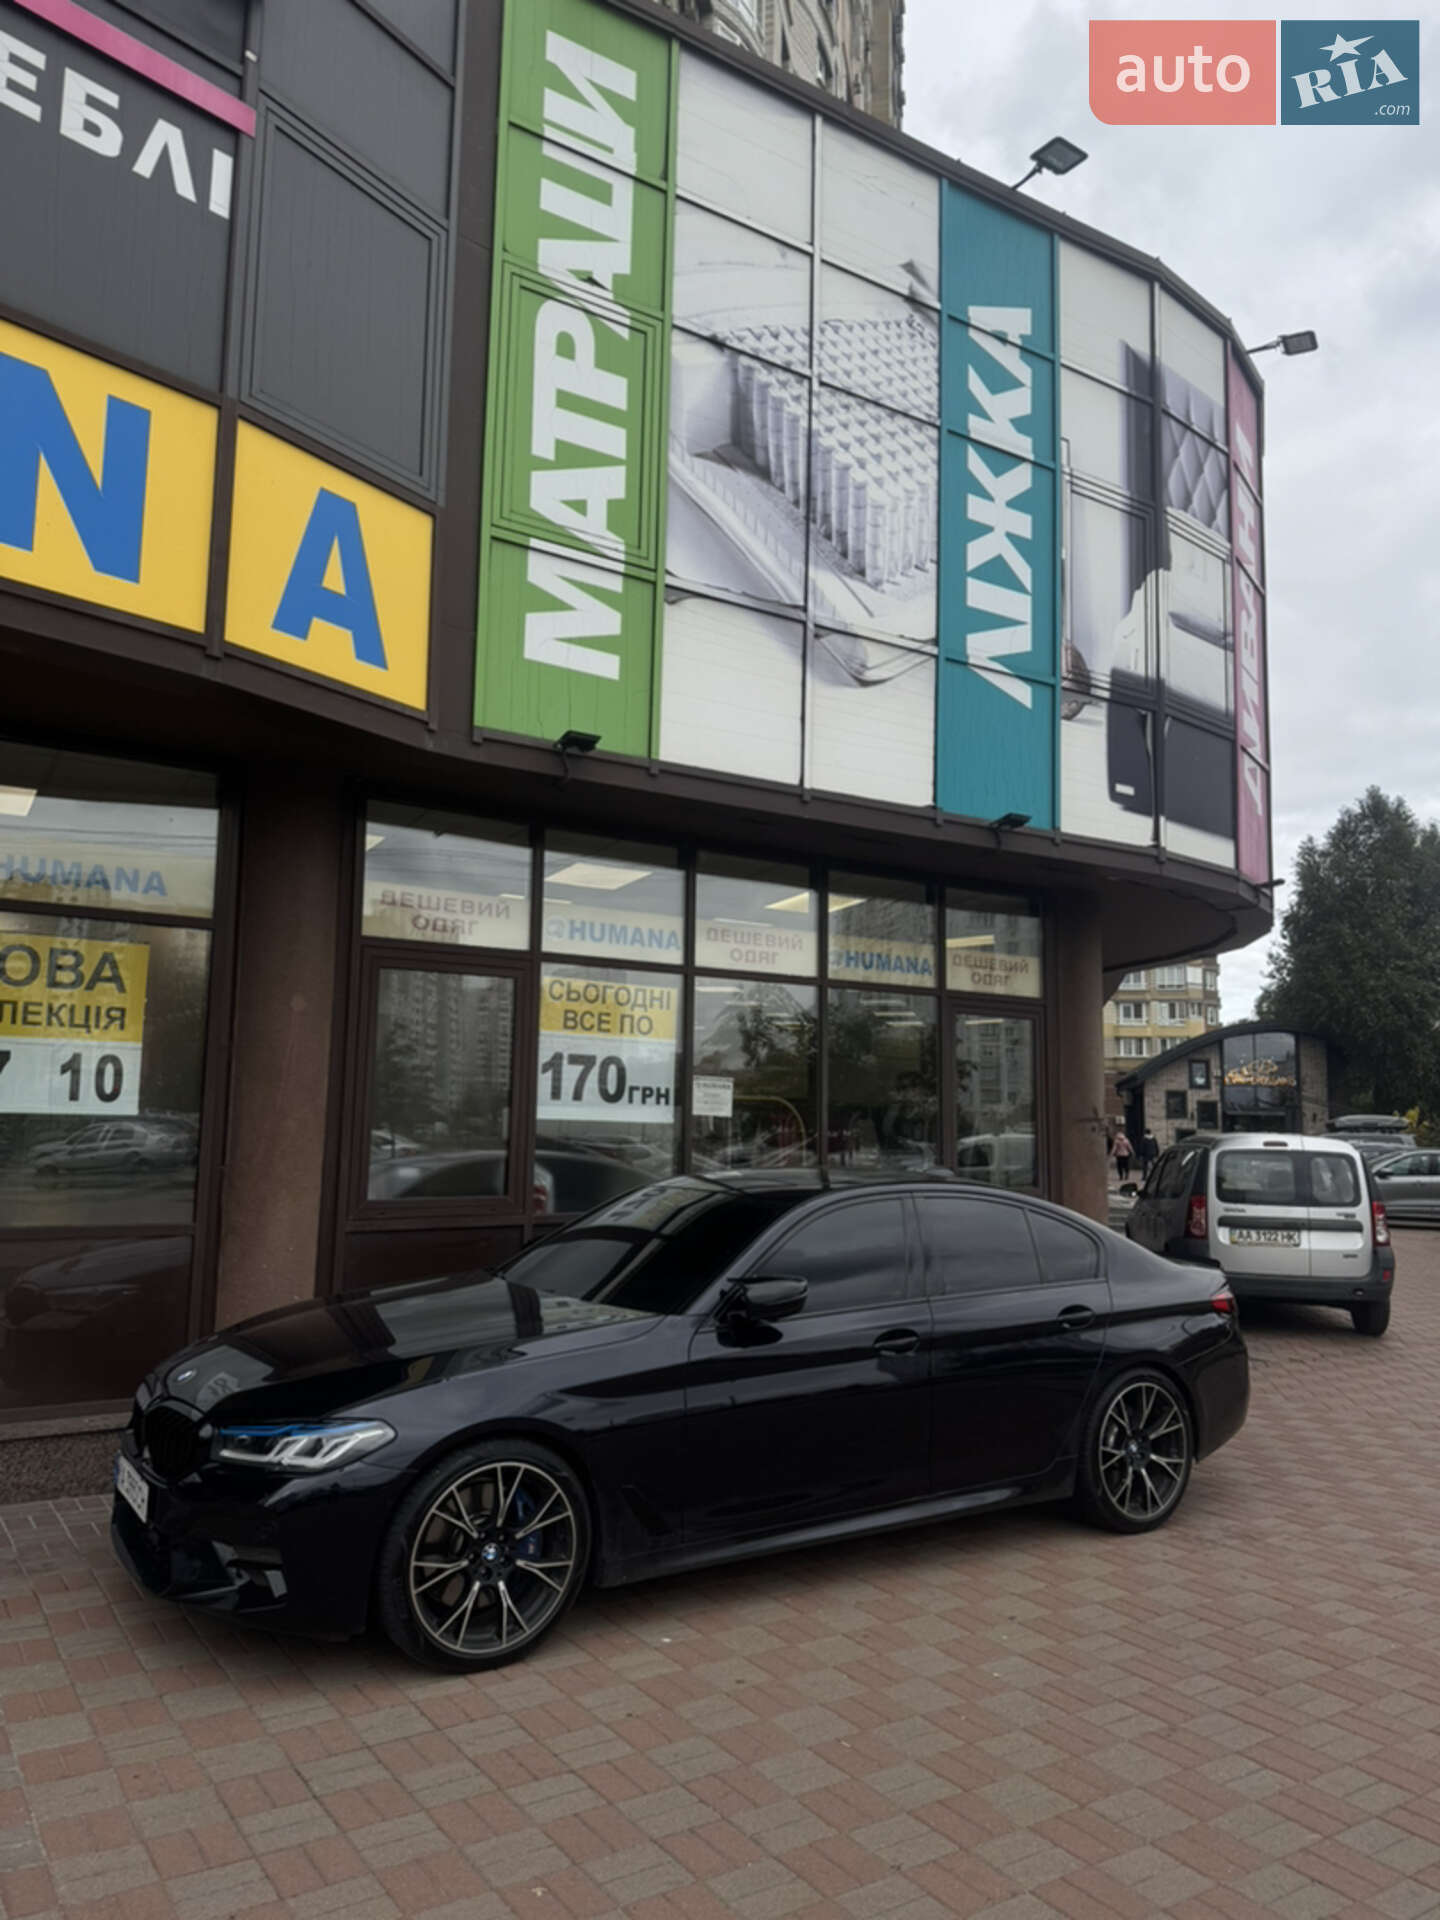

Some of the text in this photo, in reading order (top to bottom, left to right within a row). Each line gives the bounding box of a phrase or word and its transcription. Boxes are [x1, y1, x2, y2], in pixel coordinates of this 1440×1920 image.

[524, 30, 637, 681] МАТРАЦИ
[965, 305, 1033, 710] ЛІЖКА
[1235, 420, 1263, 816] ДИВАНИ
[379, 889, 511, 920] ДЕШЕВИЙ
[411, 913, 479, 936] ОДЯГ
[568, 918, 682, 951] HUMANA
[705, 926, 804, 951] ДЕШЕВИЙ
[729, 947, 780, 966] ОДЯГ
[844, 950, 934, 977] HUMANA
[951, 953, 1030, 975] ДЕШЕВИЙ
[970, 971, 1012, 988] ОДЯГ
[548, 979, 671, 1013] СЬОГОДНІ
[563, 1009, 654, 1036] ВСЕ ПО
[59, 1052, 124, 1103] 10
